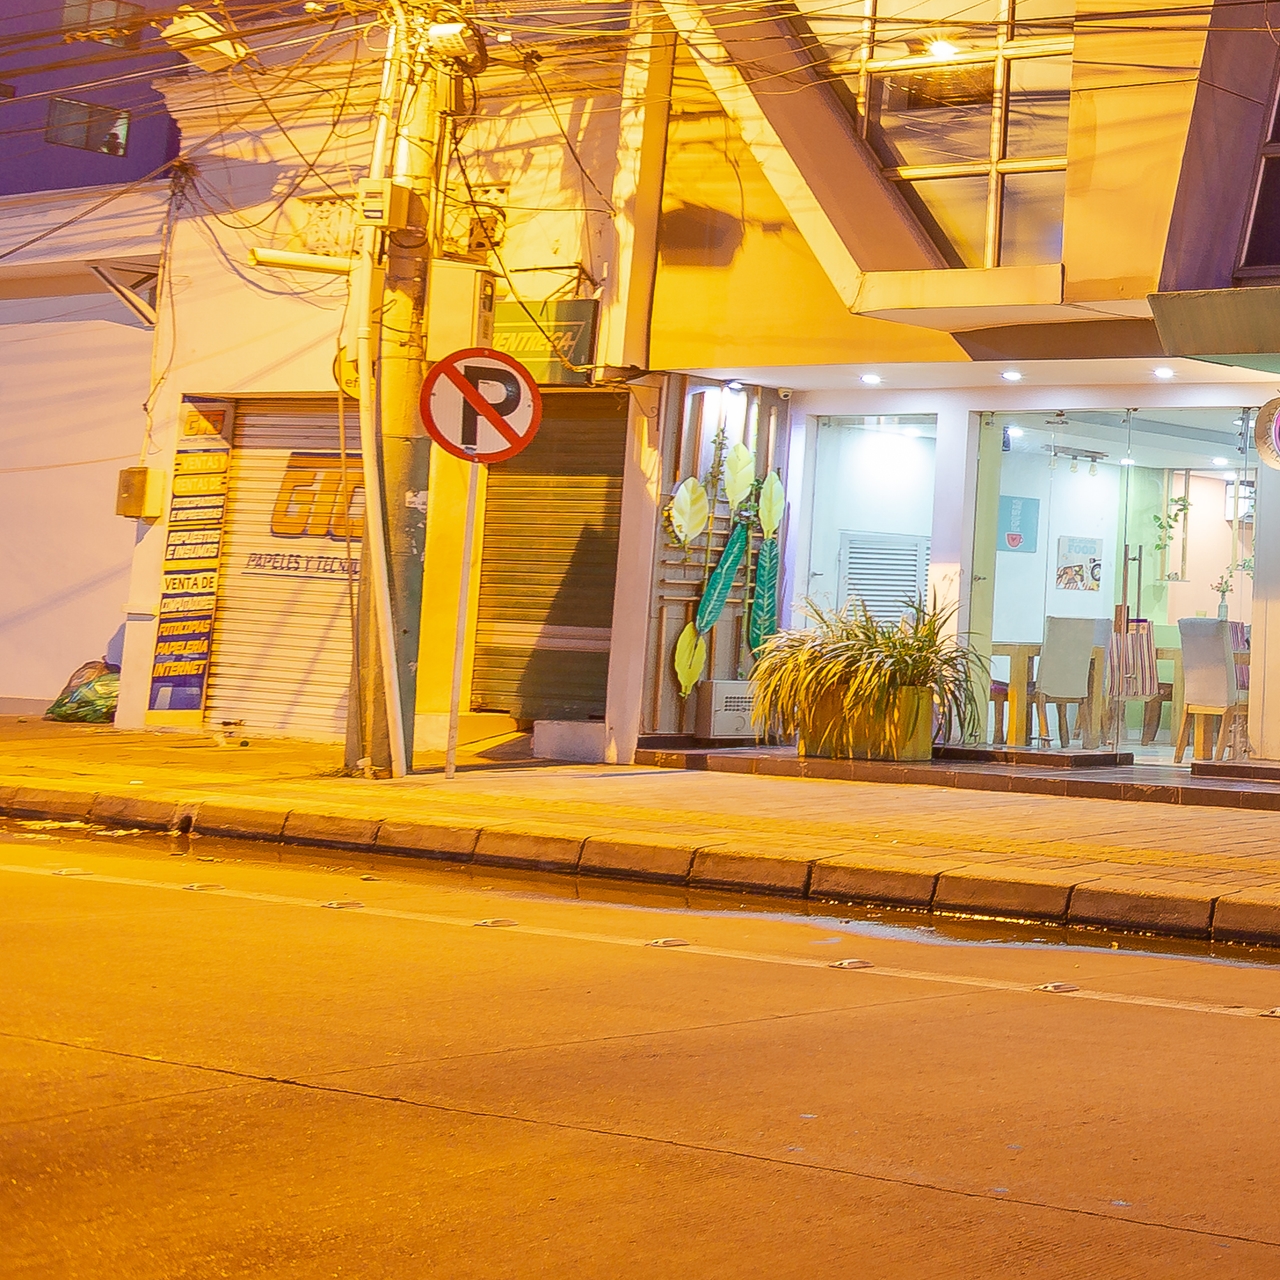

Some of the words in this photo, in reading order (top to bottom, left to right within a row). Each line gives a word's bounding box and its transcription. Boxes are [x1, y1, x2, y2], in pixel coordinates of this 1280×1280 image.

[1068, 544, 1096, 554] FOOD
[164, 577, 199, 590] VENTA
[202, 576, 214, 589] DE
[152, 660, 208, 677] INTERNET
